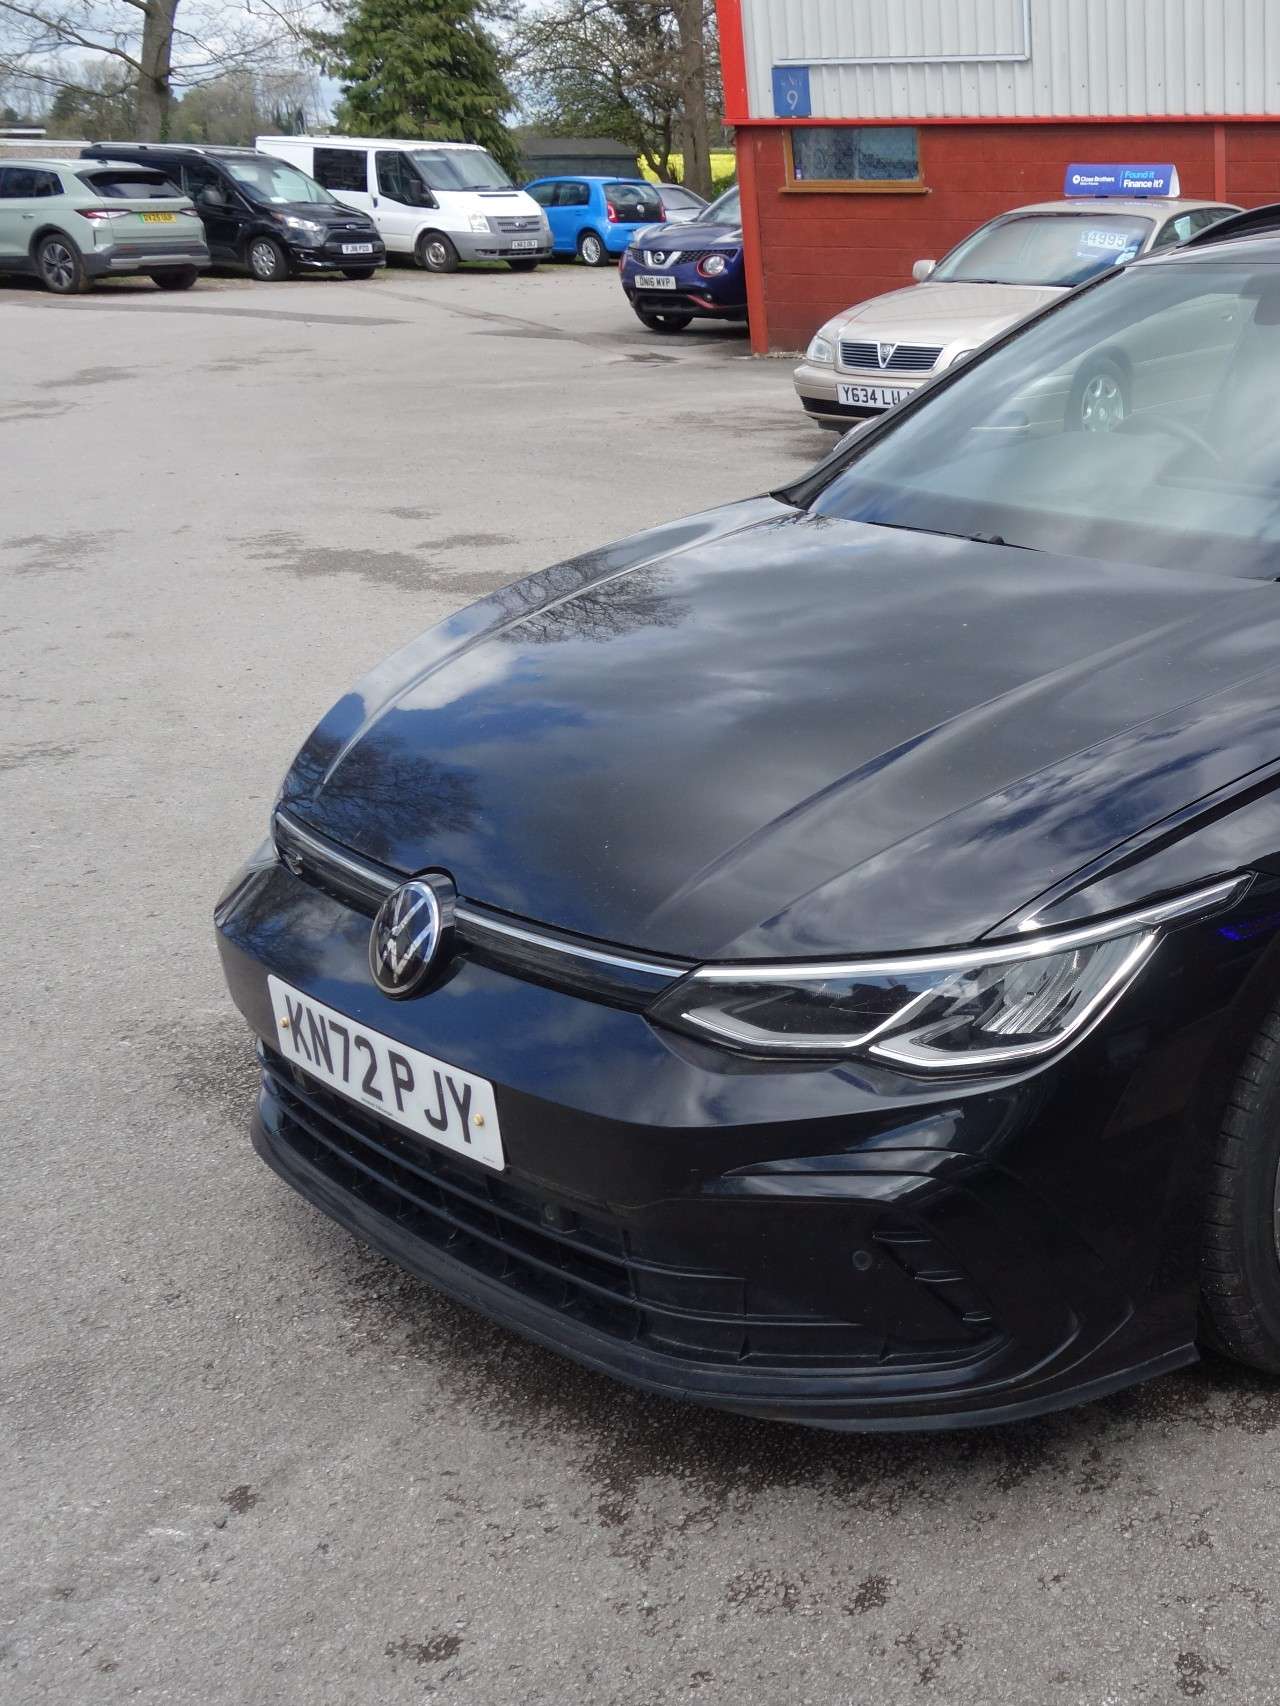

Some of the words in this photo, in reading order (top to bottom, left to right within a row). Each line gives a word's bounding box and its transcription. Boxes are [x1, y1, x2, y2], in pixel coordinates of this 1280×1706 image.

[787, 90, 798, 110] 9
[1125, 170, 1148, 179] Found
[1148, 170, 1155, 179] it
[1124, 179, 1152, 188] Finance
[657, 277, 671, 287] MVP
[843, 385, 877, 404] Y634
[284, 994, 384, 1101] KN72
[387, 1050, 472, 1144] PJY
